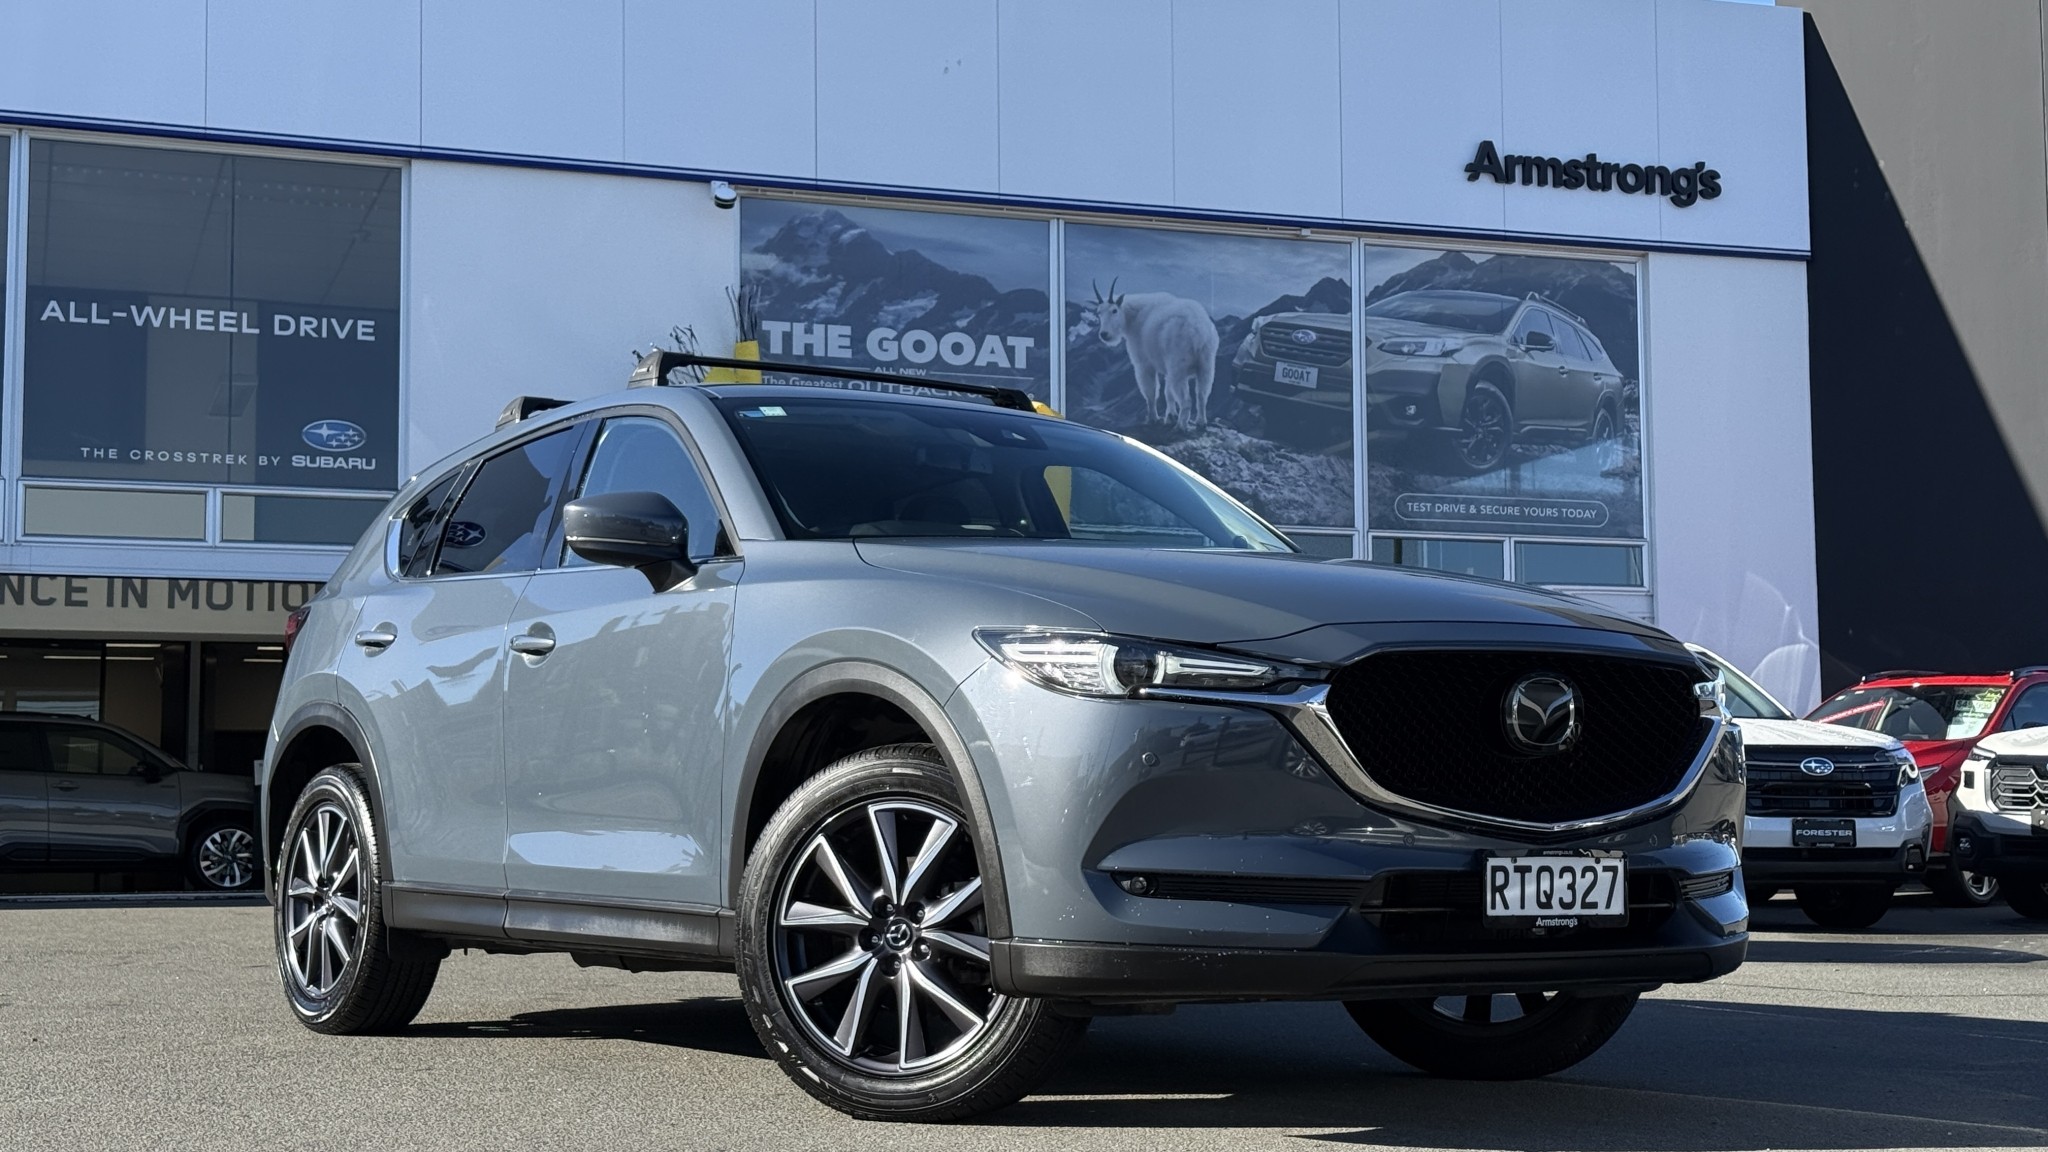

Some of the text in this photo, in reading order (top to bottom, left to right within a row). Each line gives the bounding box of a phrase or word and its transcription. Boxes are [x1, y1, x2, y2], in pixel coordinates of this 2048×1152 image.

[1464, 140, 1722, 208] Armstrong's
[40, 300, 376, 341] ALL-WHEEL DRIVE
[761, 320, 1034, 369] THE GOOAT
[762, 375, 786, 385] The
[789, 377, 844, 388] Greatest
[874, 366, 927, 376] ALL NEW
[1282, 367, 1311, 382] GOOAT
[81, 447, 376, 470] THE CROSSTREK BY SUBARU
[1407, 502, 1597, 519] TEST DRIVE & SECURE YOURS TODAY
[107, 577, 148, 608] IN
[1490, 865, 1619, 910] RTQ327
[1536, 917, 1578, 928] Armstrong's
